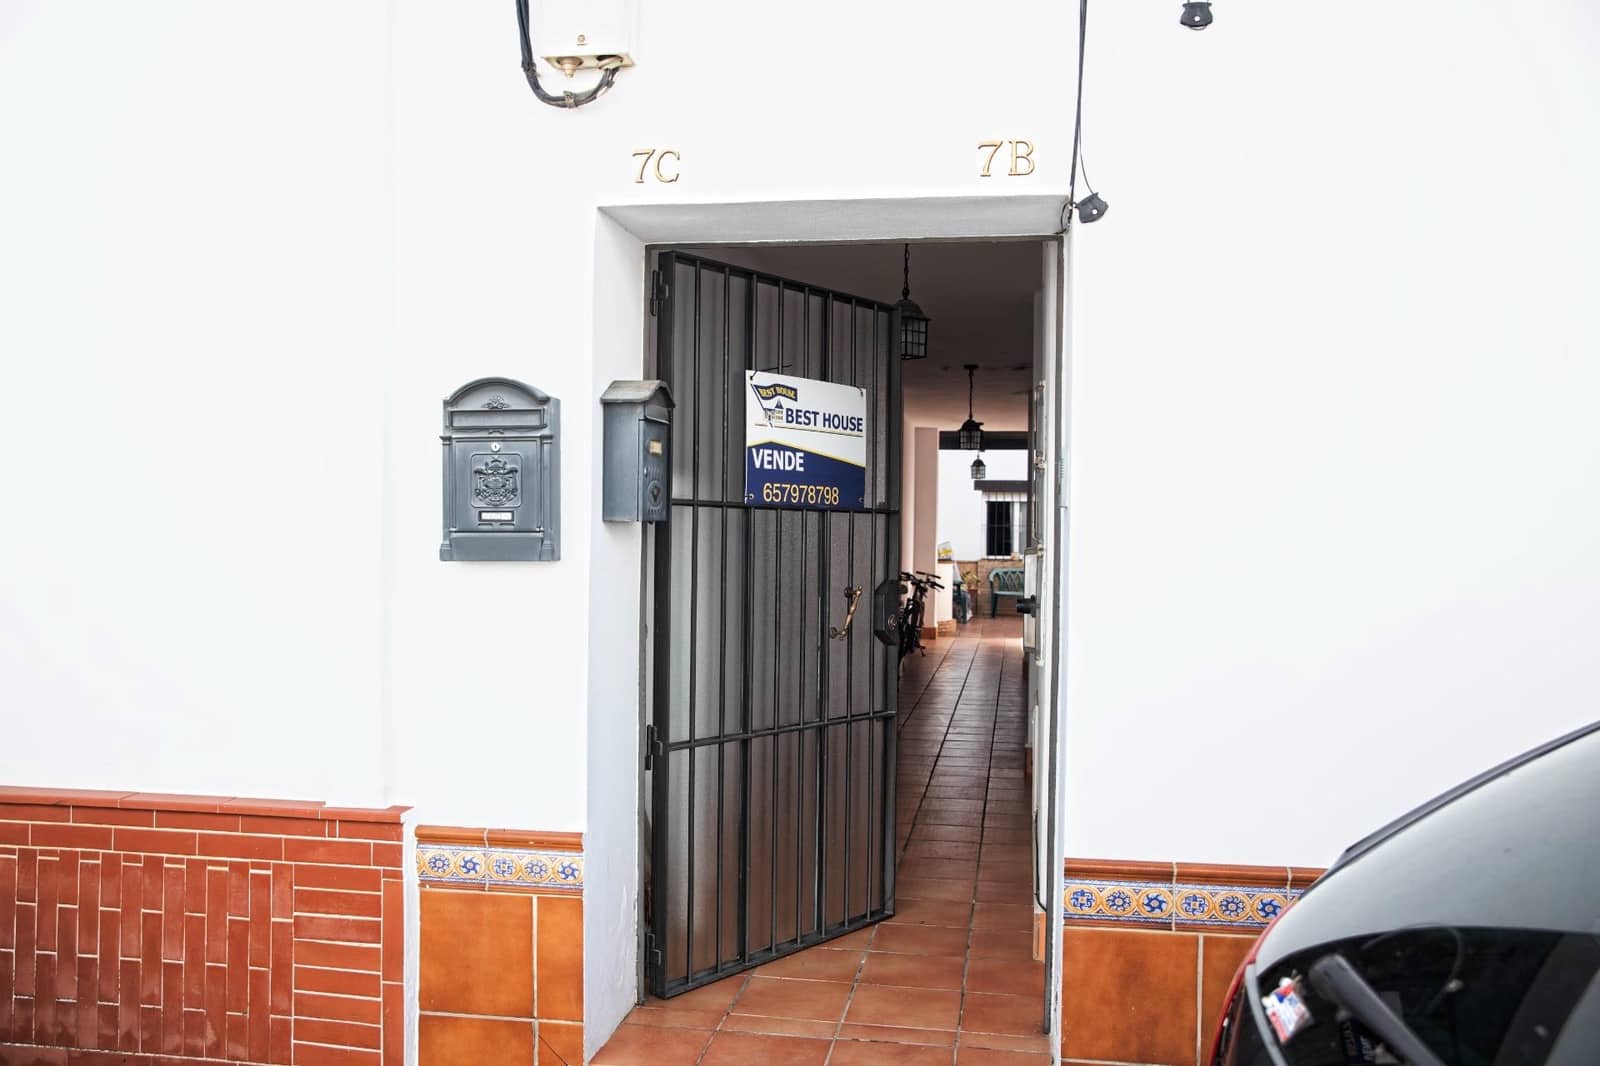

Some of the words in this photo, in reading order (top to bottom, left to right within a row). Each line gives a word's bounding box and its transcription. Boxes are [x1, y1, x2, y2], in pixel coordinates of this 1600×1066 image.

[631, 148, 681, 184] 7C
[977, 139, 1035, 177] 7B
[758, 387, 775, 398] BEST
[785, 407, 820, 427] BEST
[822, 412, 863, 433] HOUSE
[751, 447, 805, 472] VENDE
[763, 482, 840, 505] 657978798
